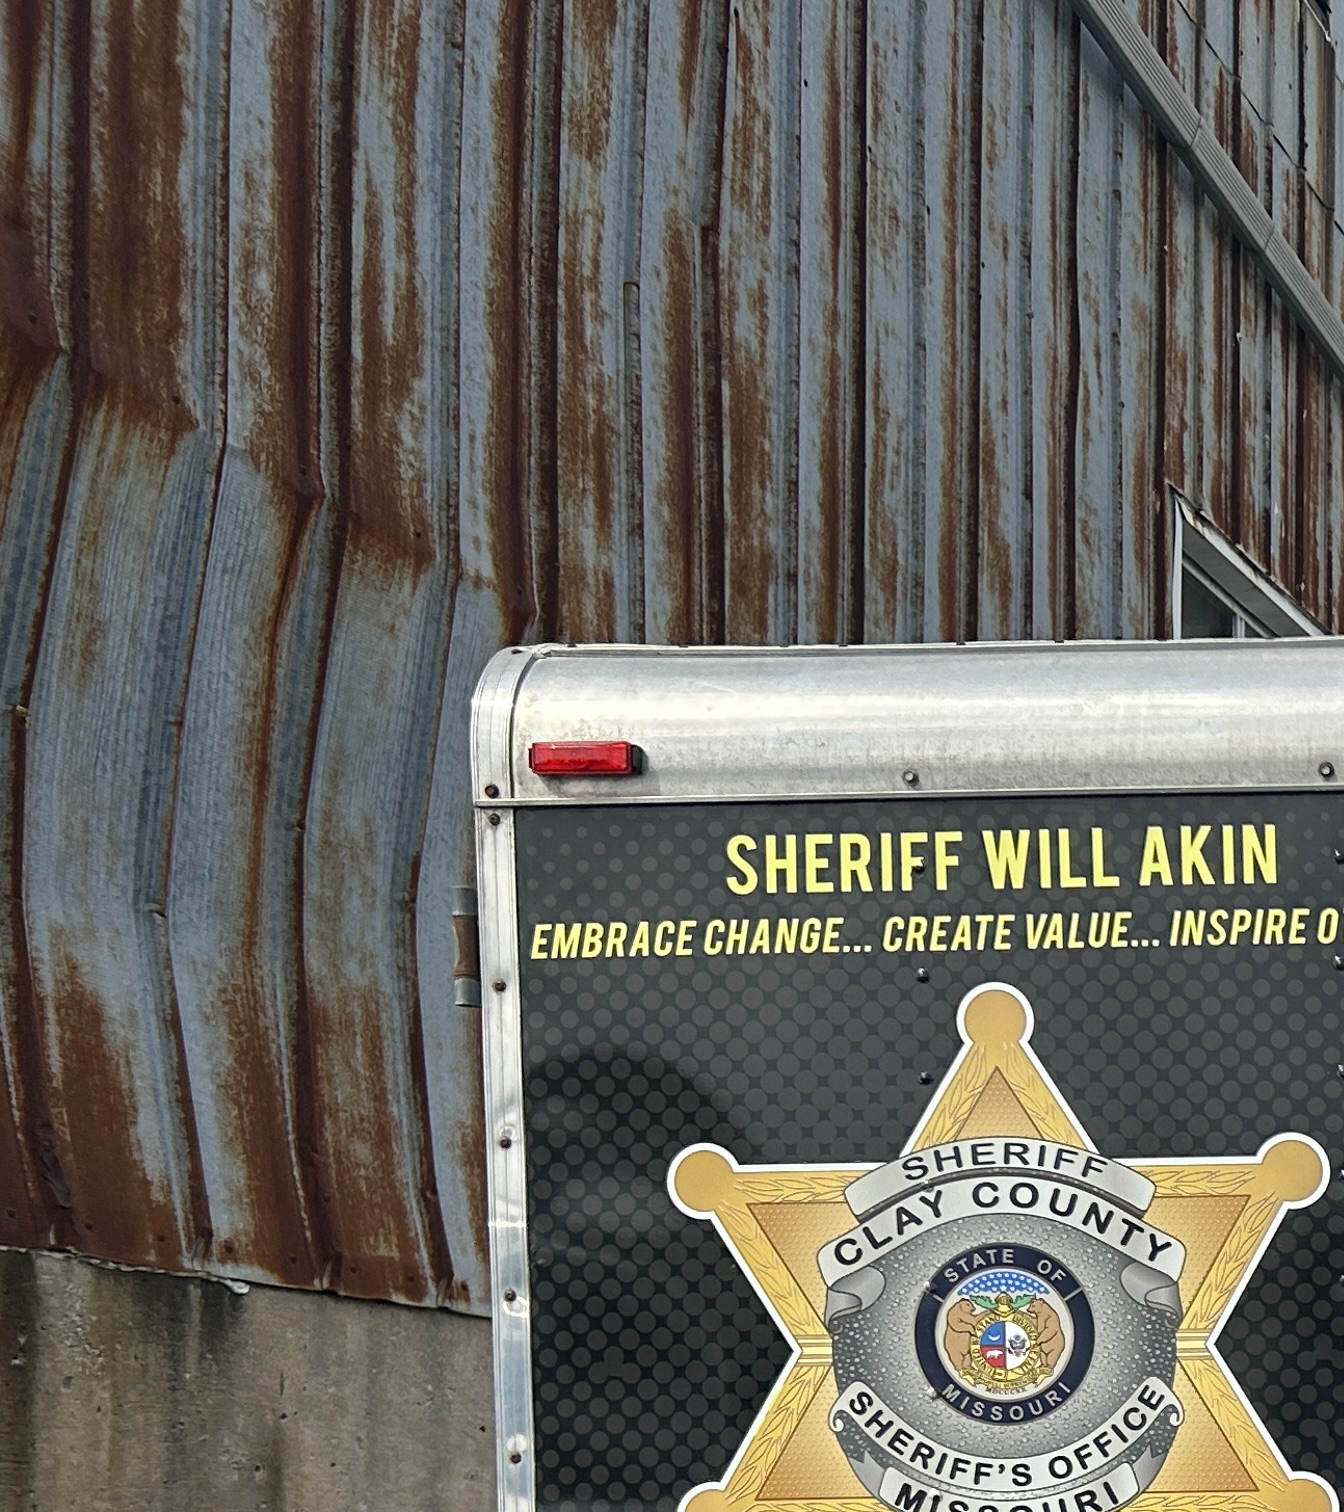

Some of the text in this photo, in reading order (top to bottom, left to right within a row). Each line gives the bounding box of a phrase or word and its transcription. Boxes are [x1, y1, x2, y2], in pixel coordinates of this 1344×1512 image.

[725, 825, 1278, 895] SHERIFF WILL AKIN
[531, 920, 692, 959] EMBRACE
[704, 918, 873, 955] CHANGE...
[884, 916, 1012, 951] CREATE
[1024, 913, 1161, 950] VALUE...
[1169, 911, 1308, 947] INSPIRE
[903, 1143, 1109, 1182] SHERIFF
[832, 1183, 1176, 1268] CLAY COUNTY
[944, 1248, 1067, 1284] STATE OF
[941, 1381, 1072, 1422] MISSOURI
[847, 1385, 1167, 1488] SHERIFF'S OFFICE
